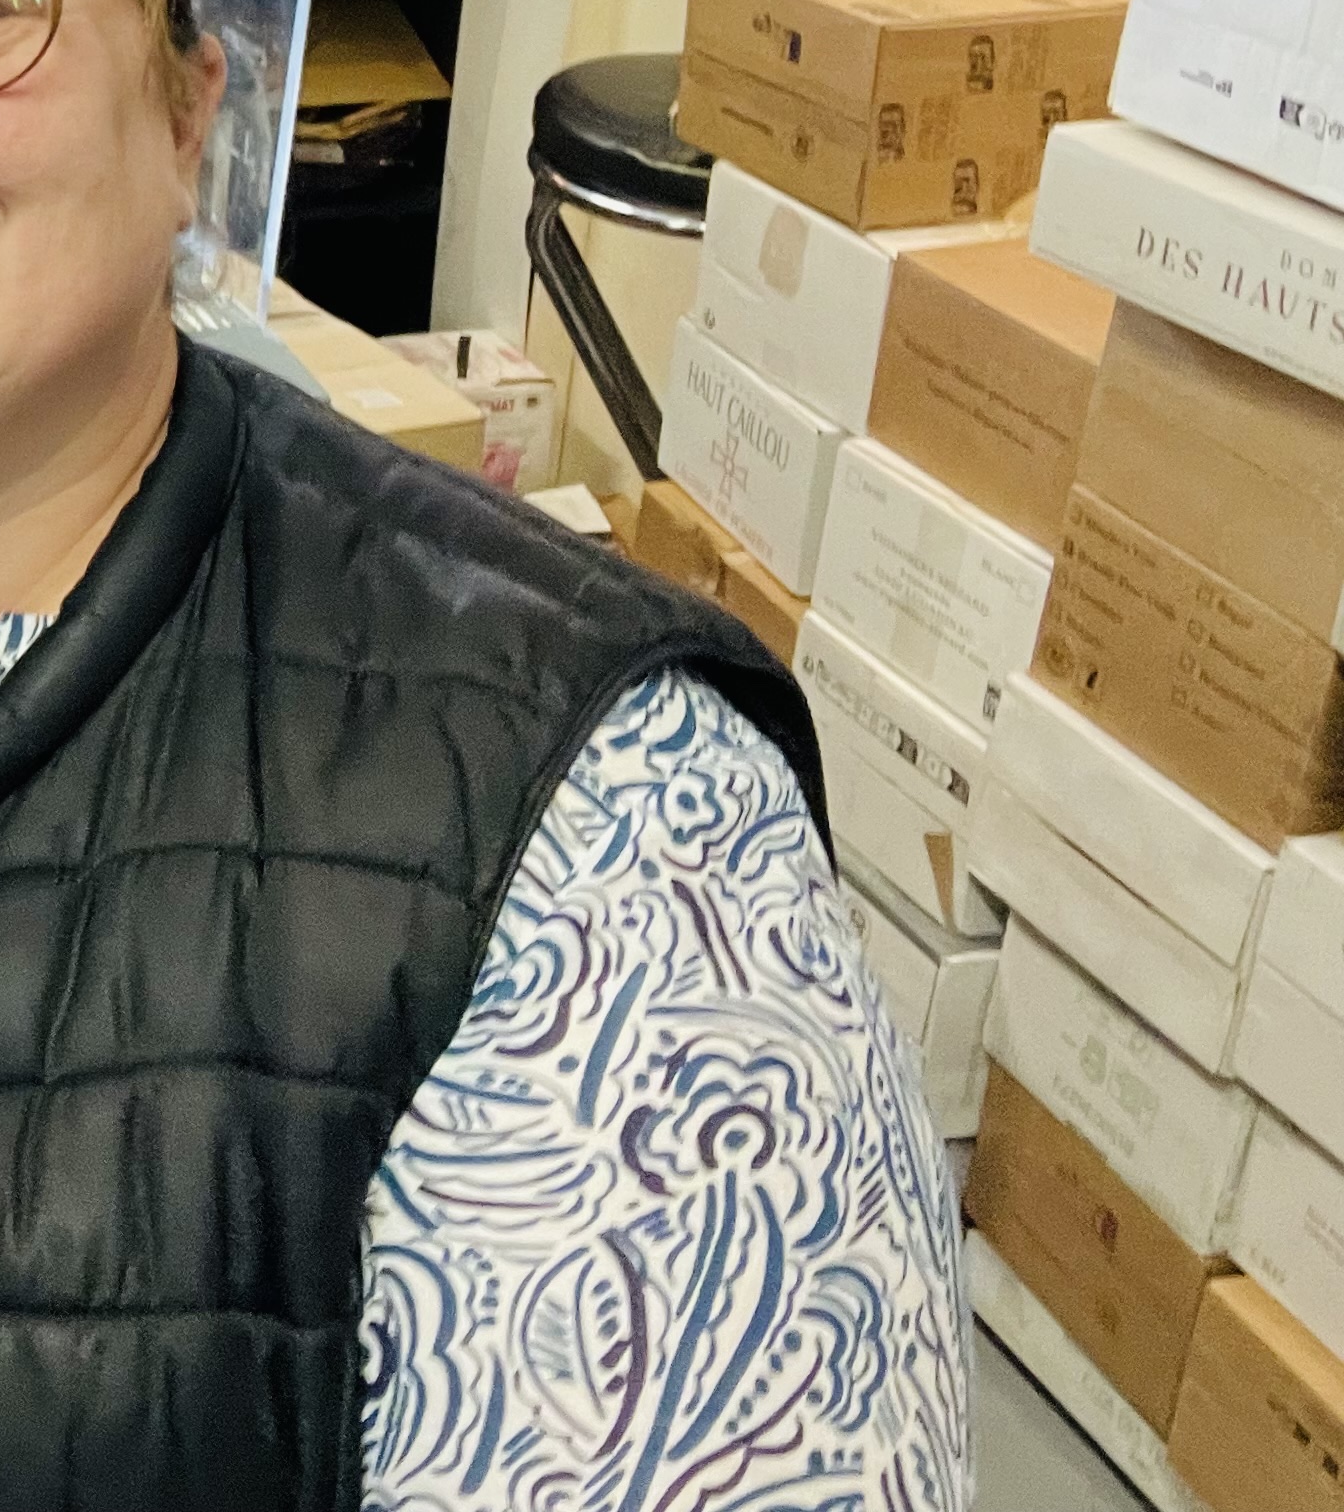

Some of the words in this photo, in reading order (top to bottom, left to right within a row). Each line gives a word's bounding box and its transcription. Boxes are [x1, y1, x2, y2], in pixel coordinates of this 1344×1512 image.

[1136, 226, 1203, 280] DES
[687, 361, 724, 415] HAUT
[727, 398, 791, 472] CAILLOU
